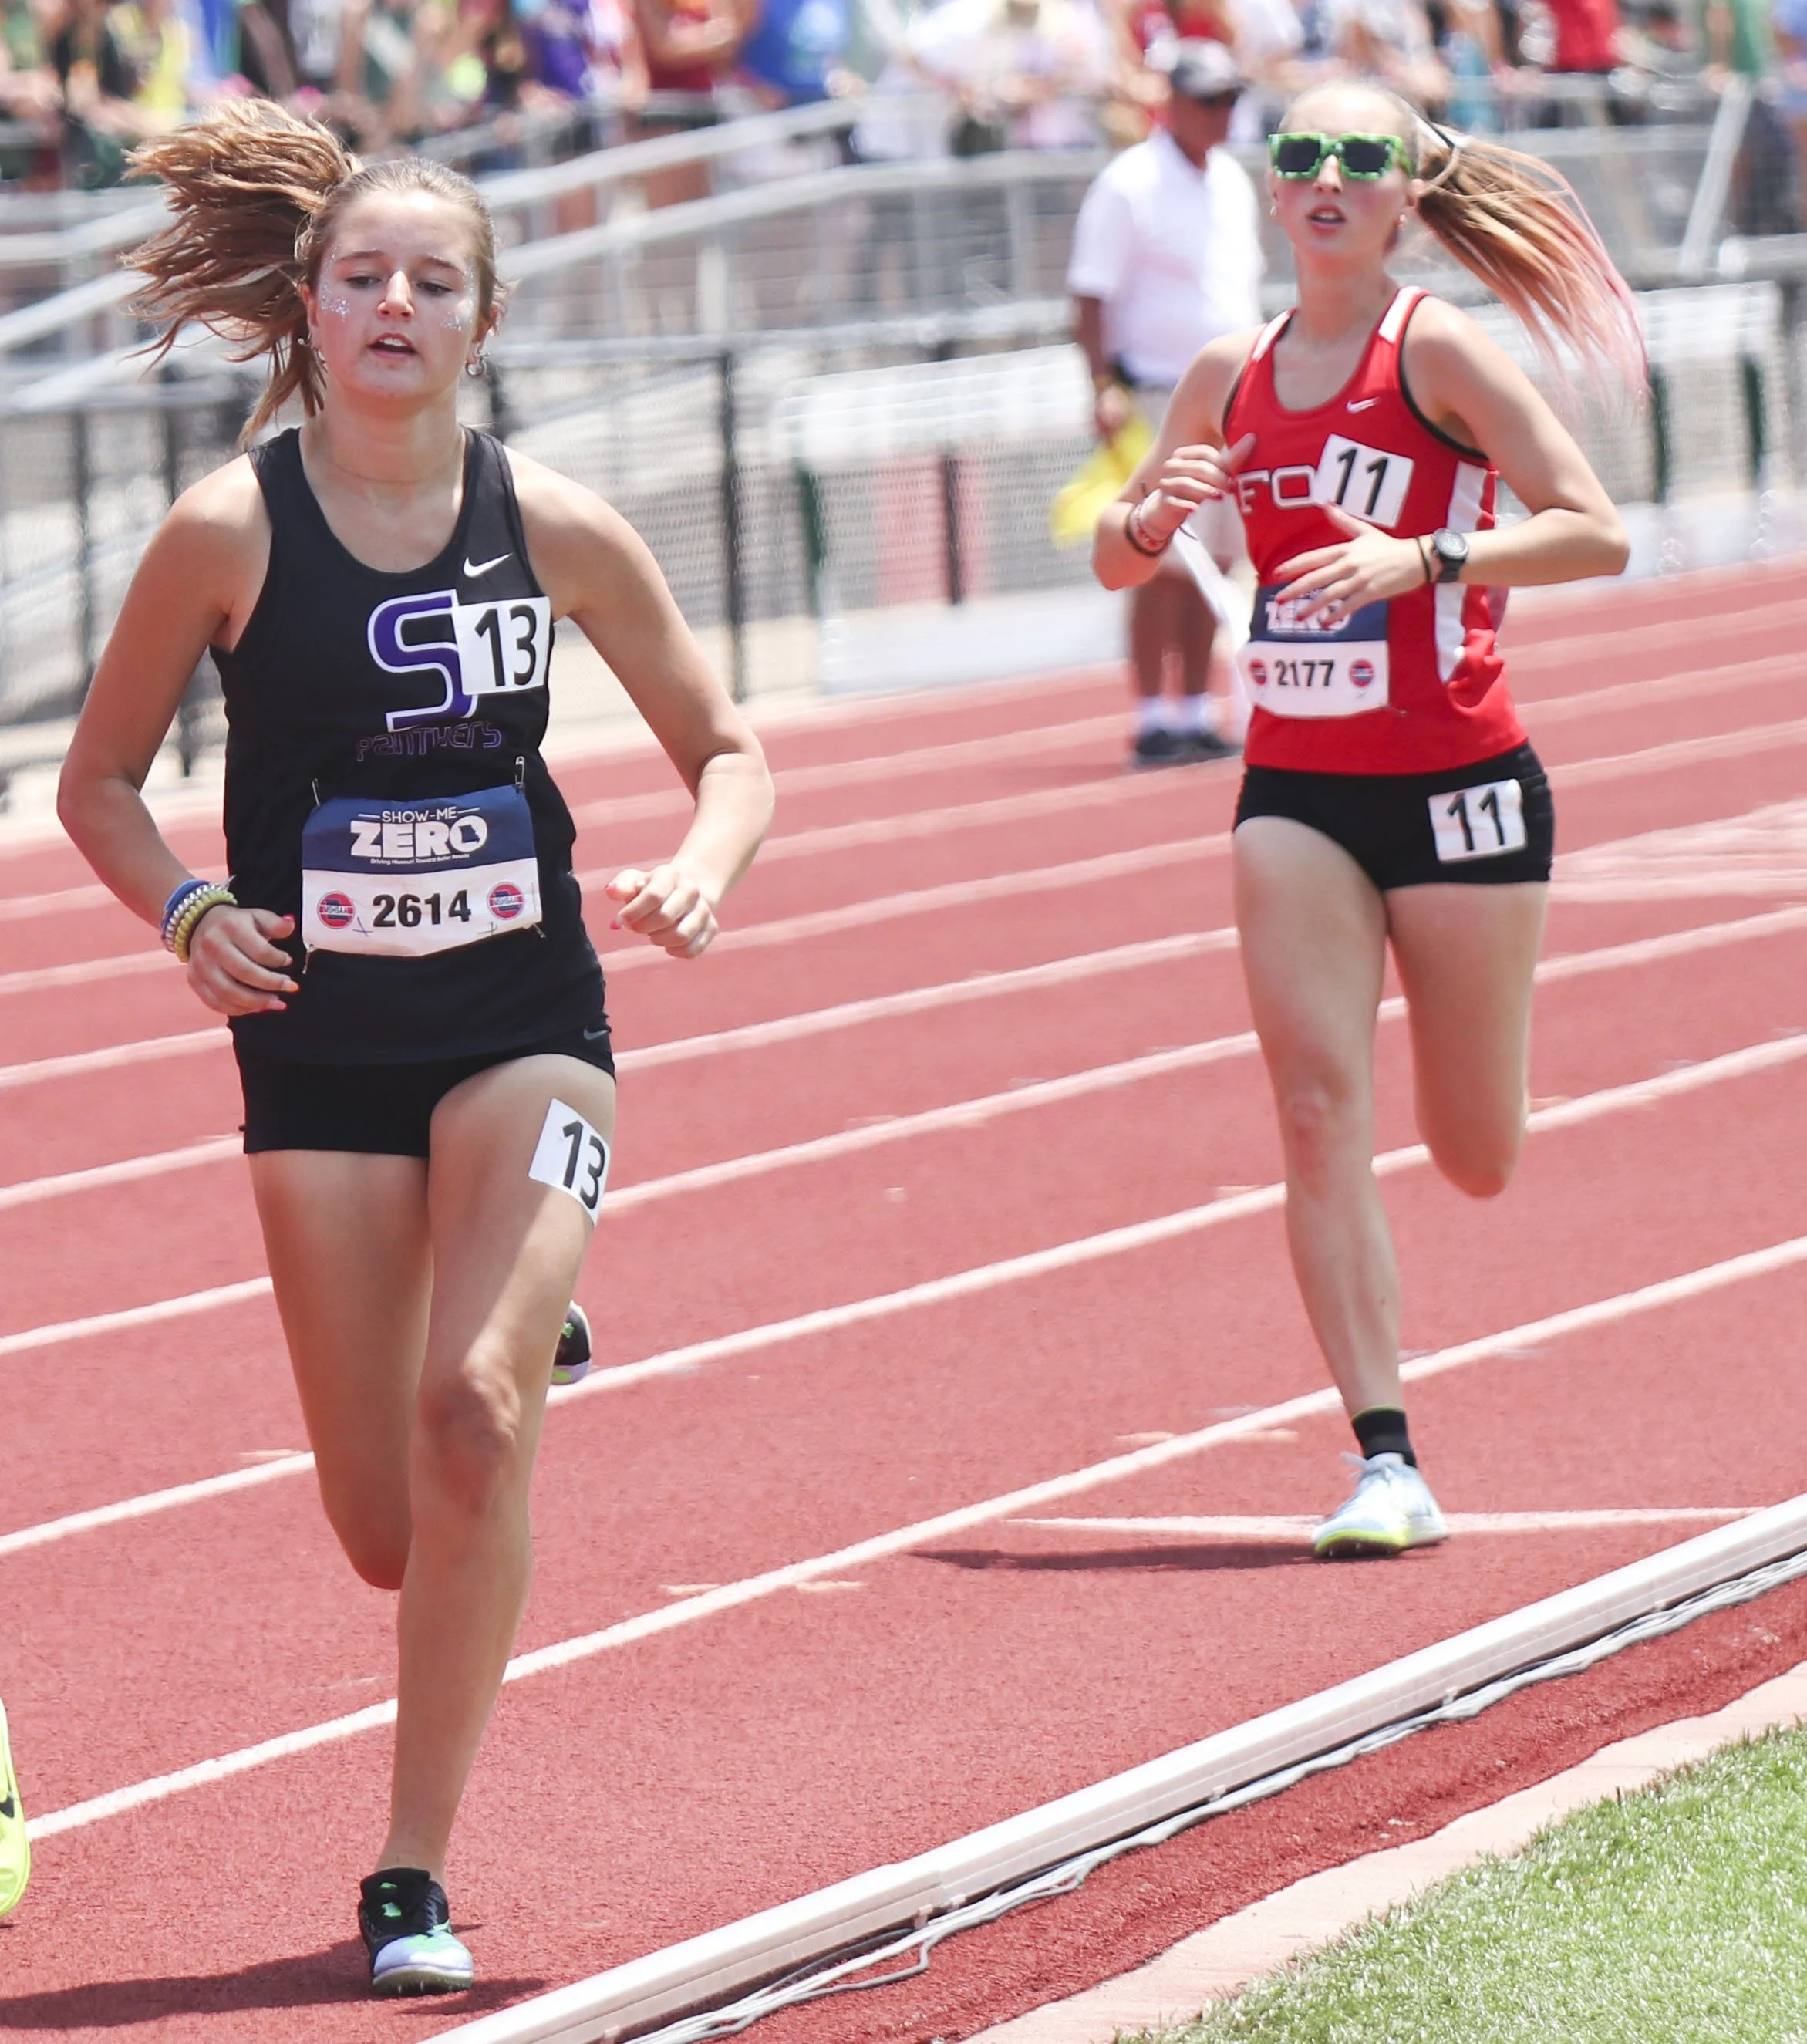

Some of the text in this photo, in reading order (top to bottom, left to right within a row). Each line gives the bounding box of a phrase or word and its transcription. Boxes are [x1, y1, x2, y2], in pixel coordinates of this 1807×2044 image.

[1337, 447, 1389, 516] 11
[474, 604, 537, 686] 13
[1275, 659, 1334, 687] 2177
[350, 815, 488, 858] ZERO
[381, 806, 457, 823] SHOW-ME
[1447, 787, 1505, 852] 11
[372, 889, 472, 928] 2614
[562, 1119, 606, 1210] 13
